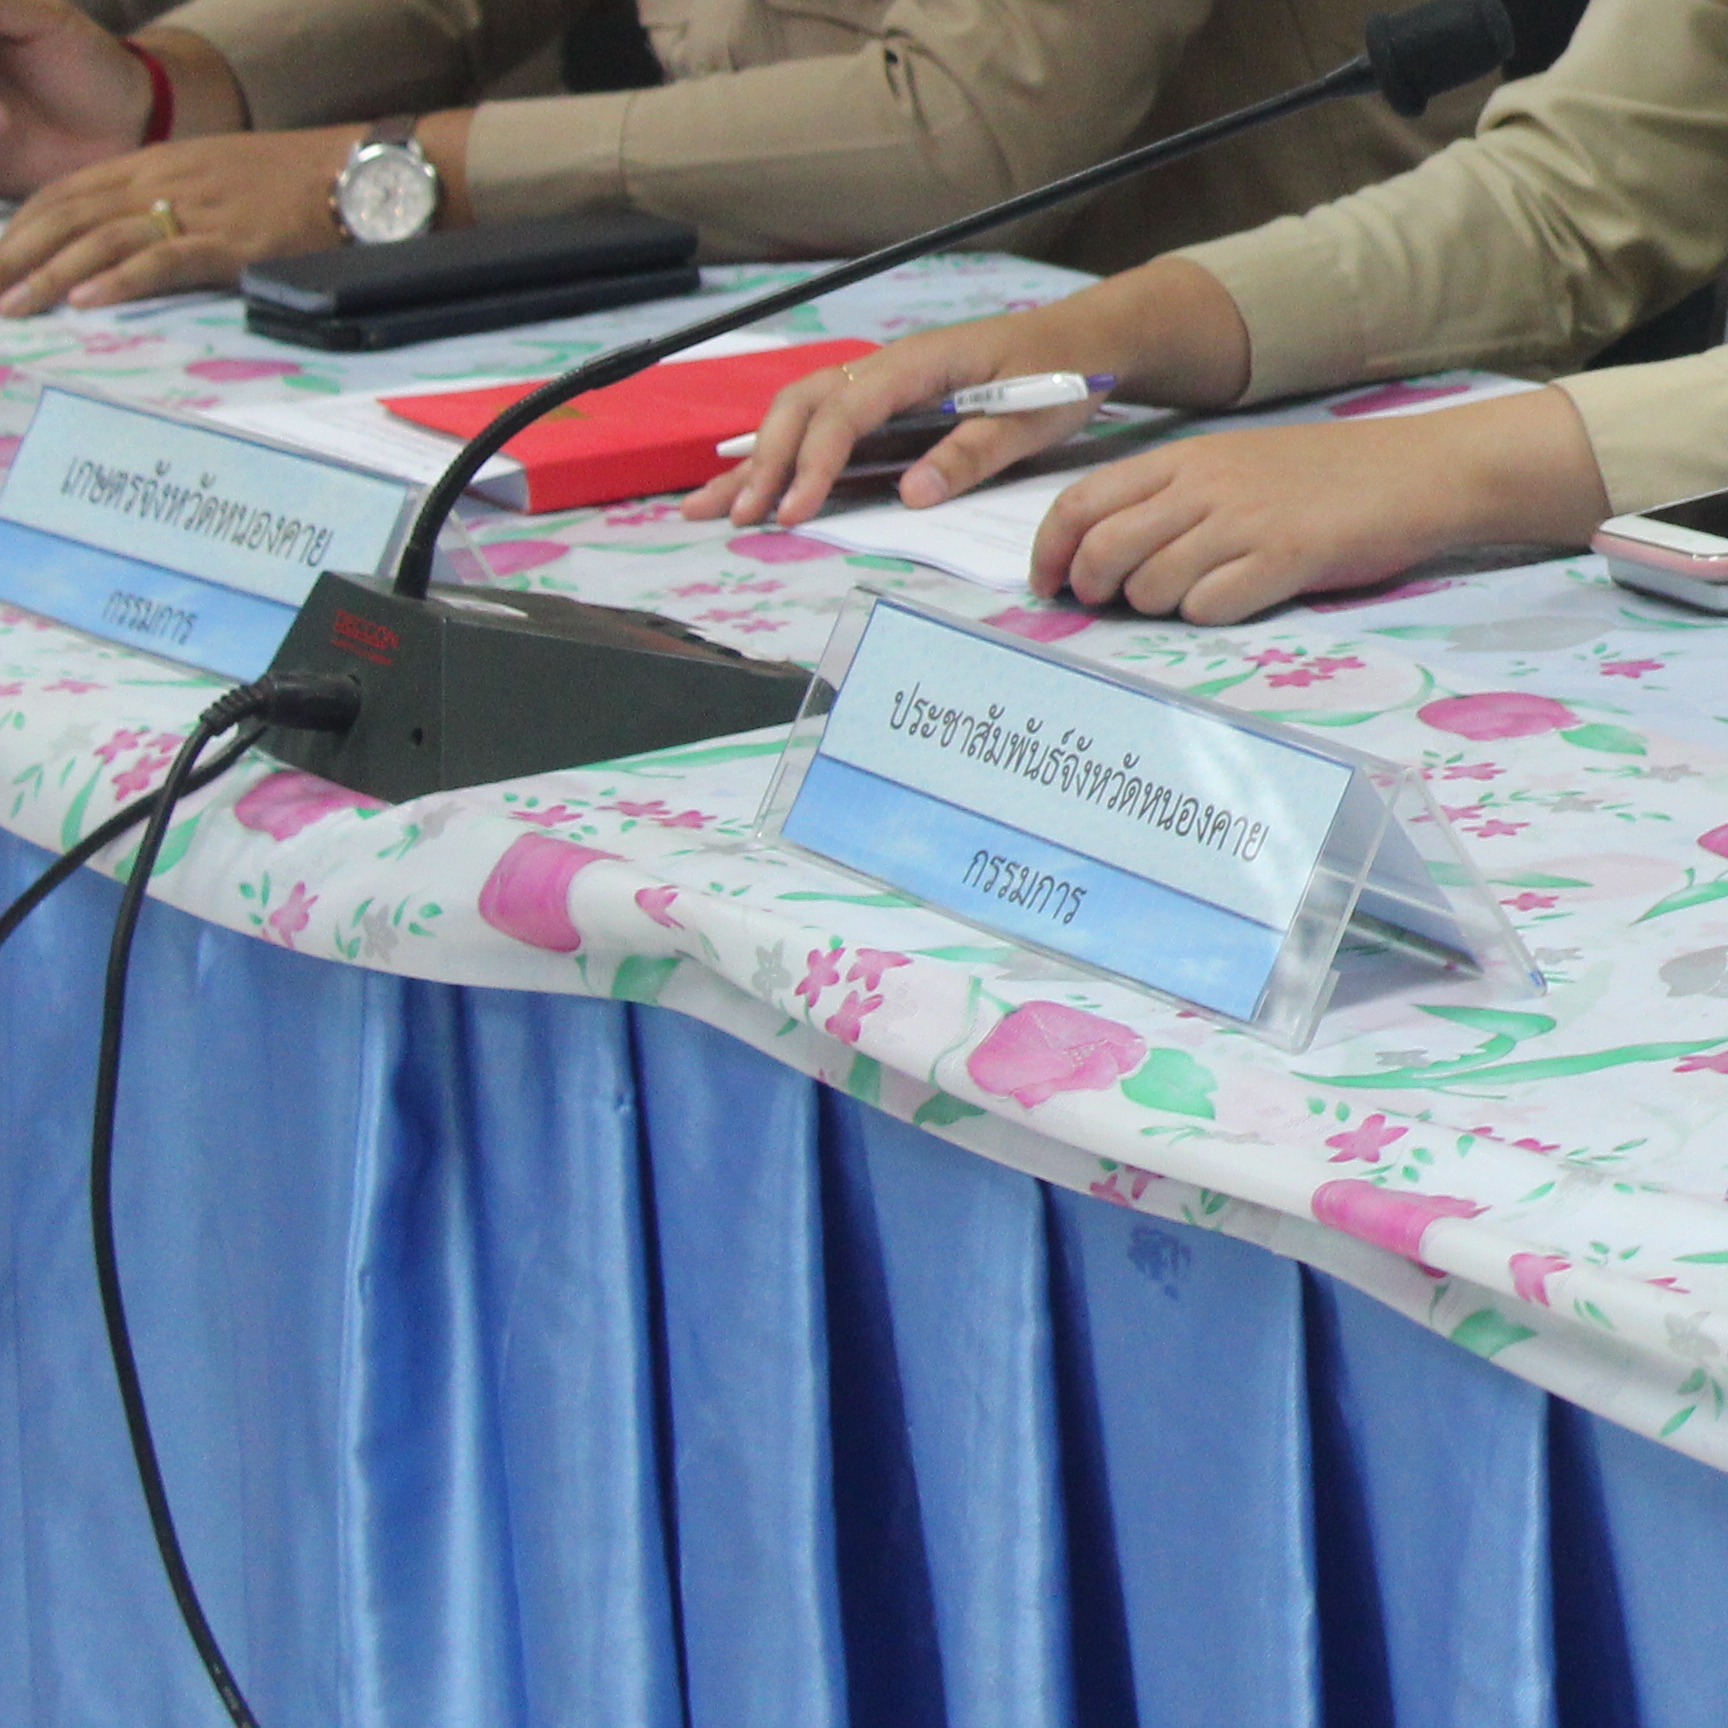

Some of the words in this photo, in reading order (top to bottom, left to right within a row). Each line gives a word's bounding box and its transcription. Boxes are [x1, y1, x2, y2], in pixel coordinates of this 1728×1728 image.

[60, 455, 334, 568] เกษตรจังหวัดหนองคาย
[103, 589, 198, 645] กรรมการ
[888, 681, 1270, 863] ประชาสัมพันธ์จังหวัดหนองคาย
[961, 847, 1088, 925] กรรมการ
